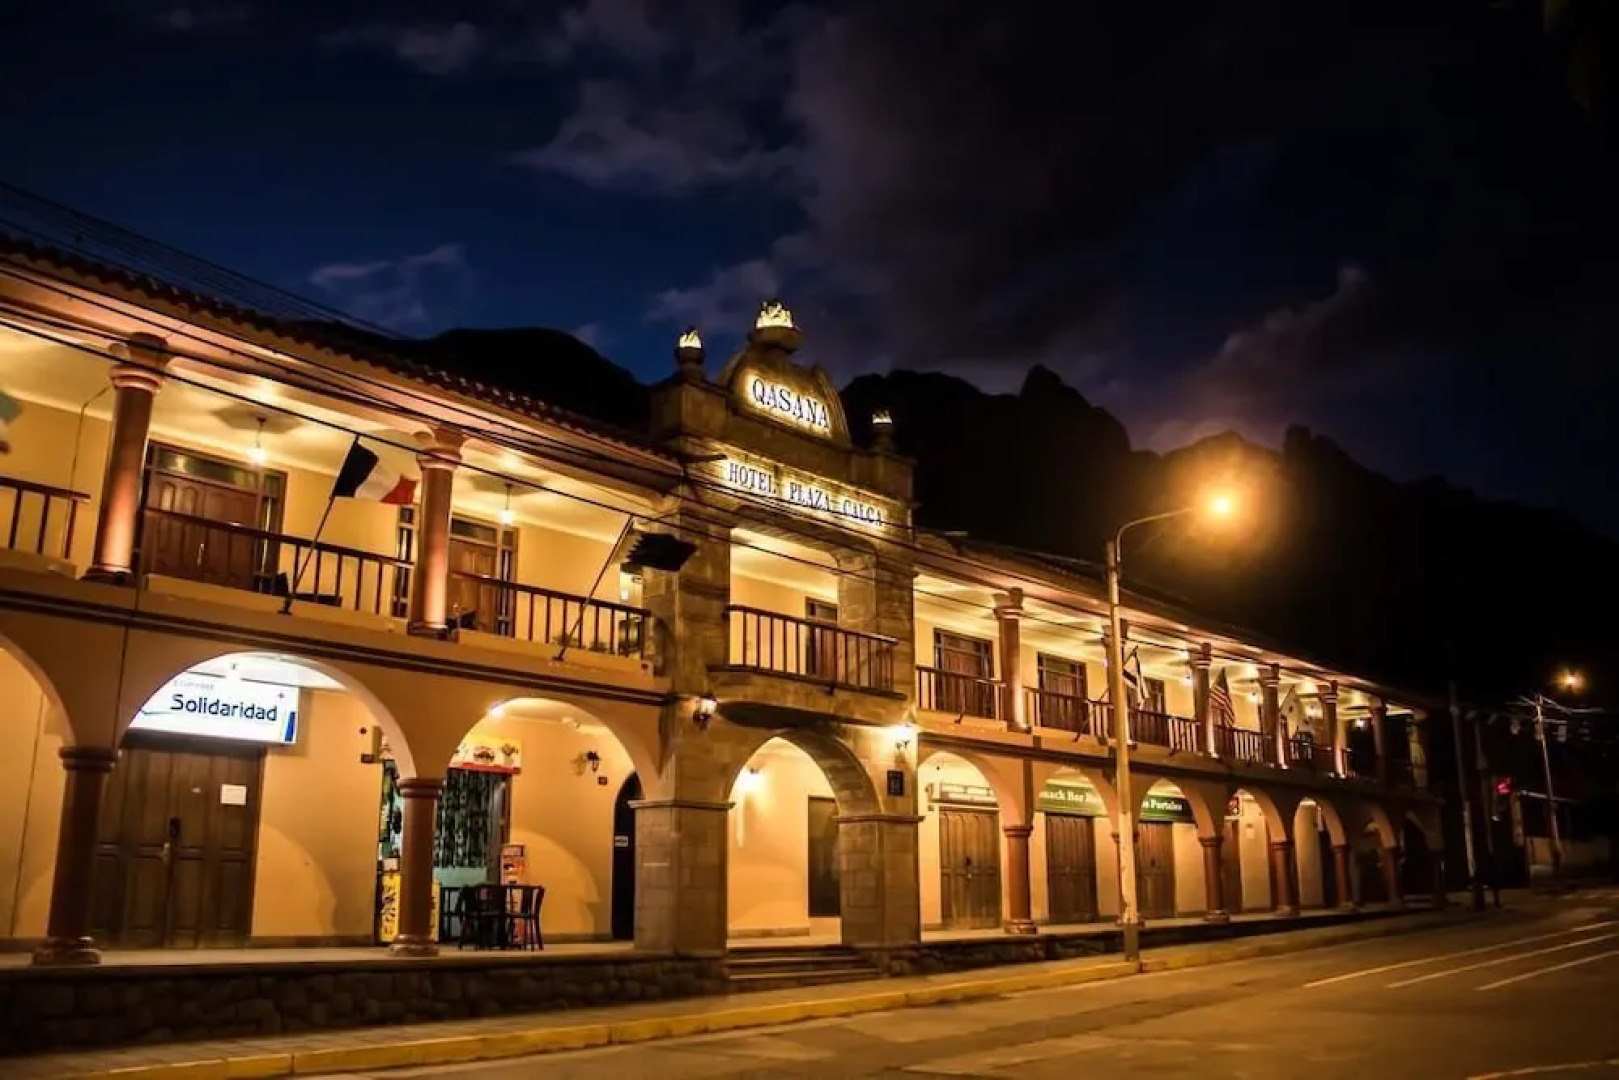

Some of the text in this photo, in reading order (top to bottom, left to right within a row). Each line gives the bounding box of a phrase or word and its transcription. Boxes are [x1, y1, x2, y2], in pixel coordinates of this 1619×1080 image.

[752, 378, 829, 428] QASANA
[729, 462, 882, 527] HOTEL PLAZA CALCA
[170, 693, 278, 722] Solidaridad
